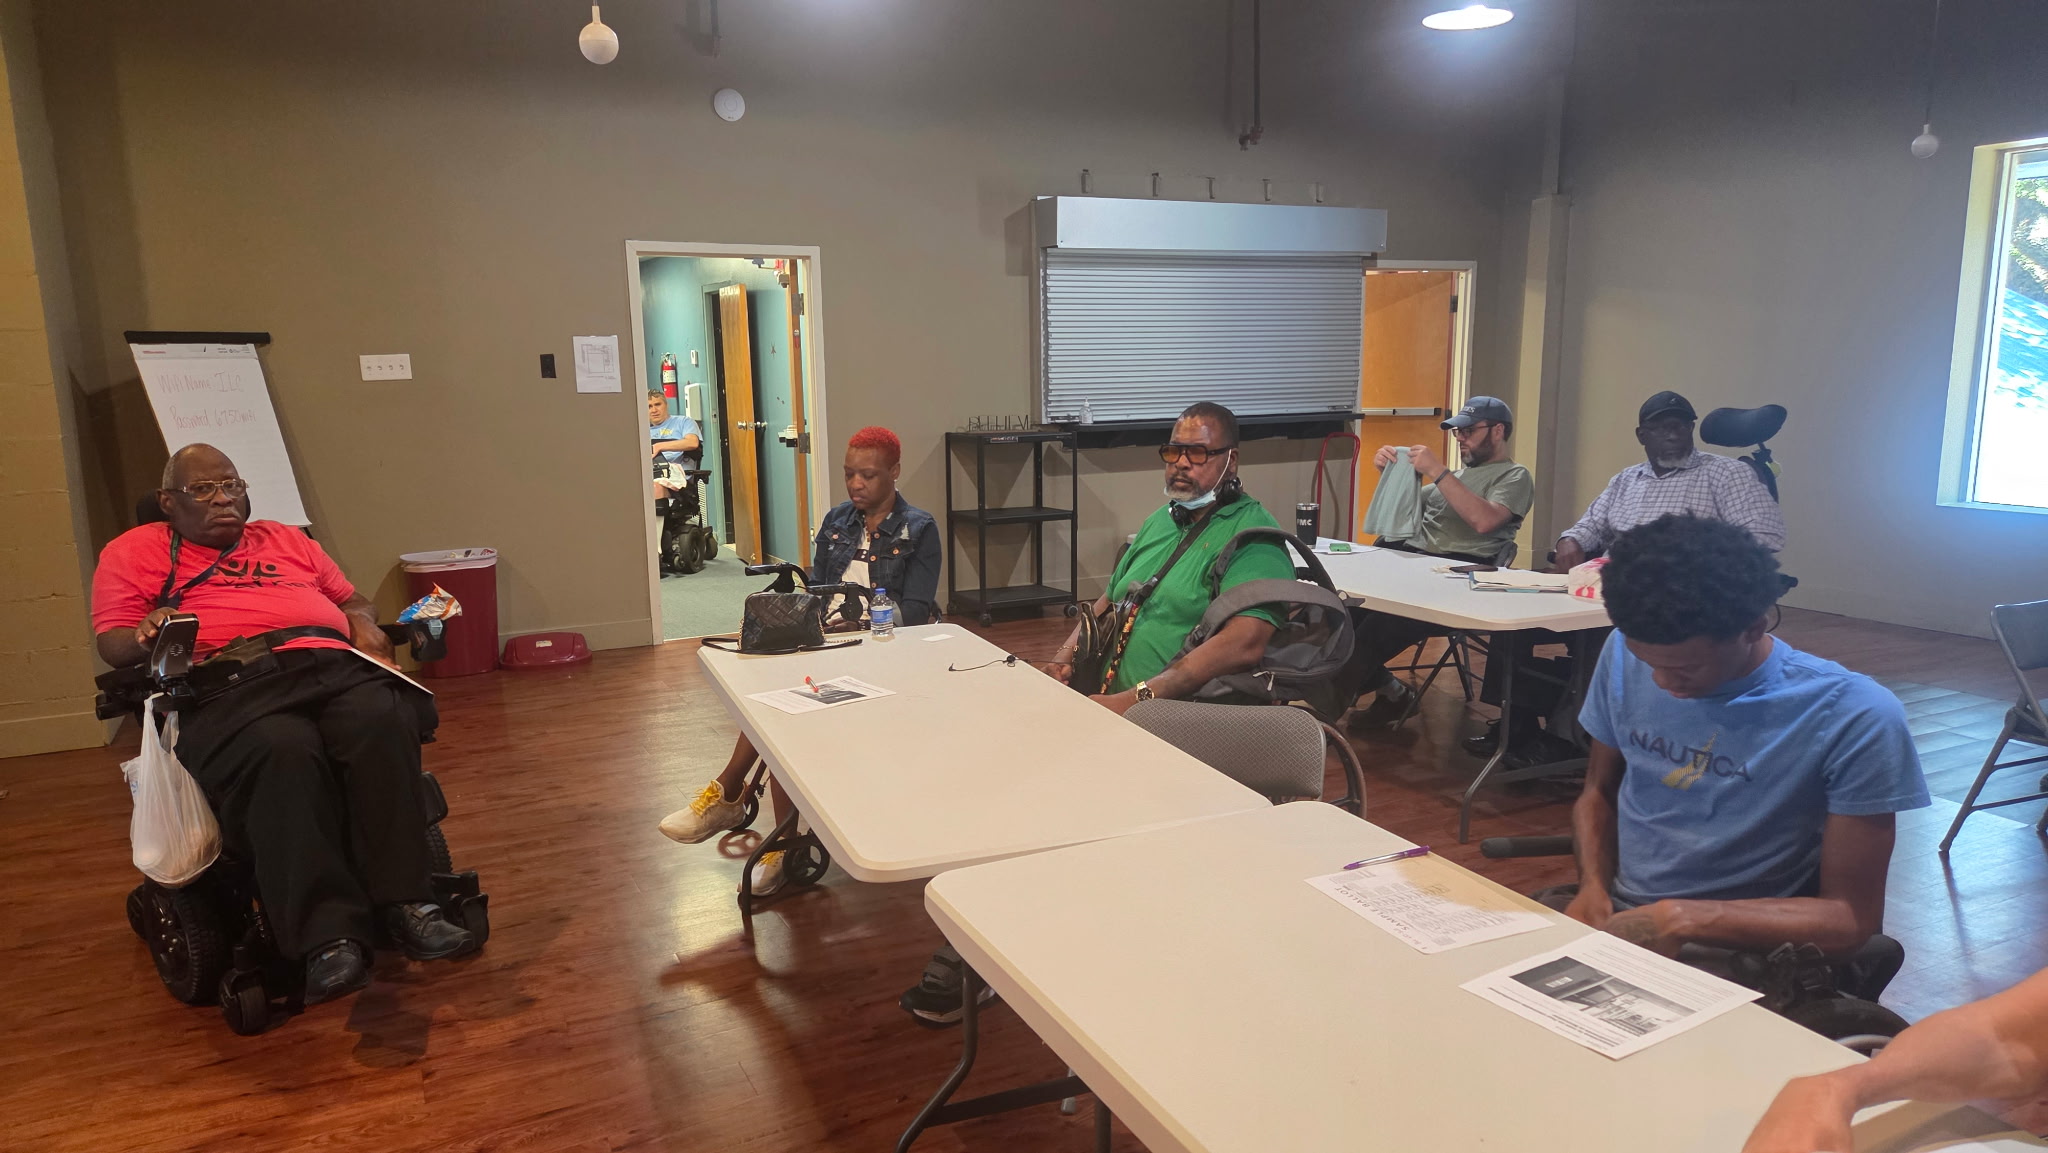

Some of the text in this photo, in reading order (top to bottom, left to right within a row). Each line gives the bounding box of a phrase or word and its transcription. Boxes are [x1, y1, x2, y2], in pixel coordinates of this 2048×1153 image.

[1629, 729, 1752, 782] NAUTICA
[1334, 887, 1371, 908] BALLOT
[1370, 908, 1410, 931] SAMPLE
